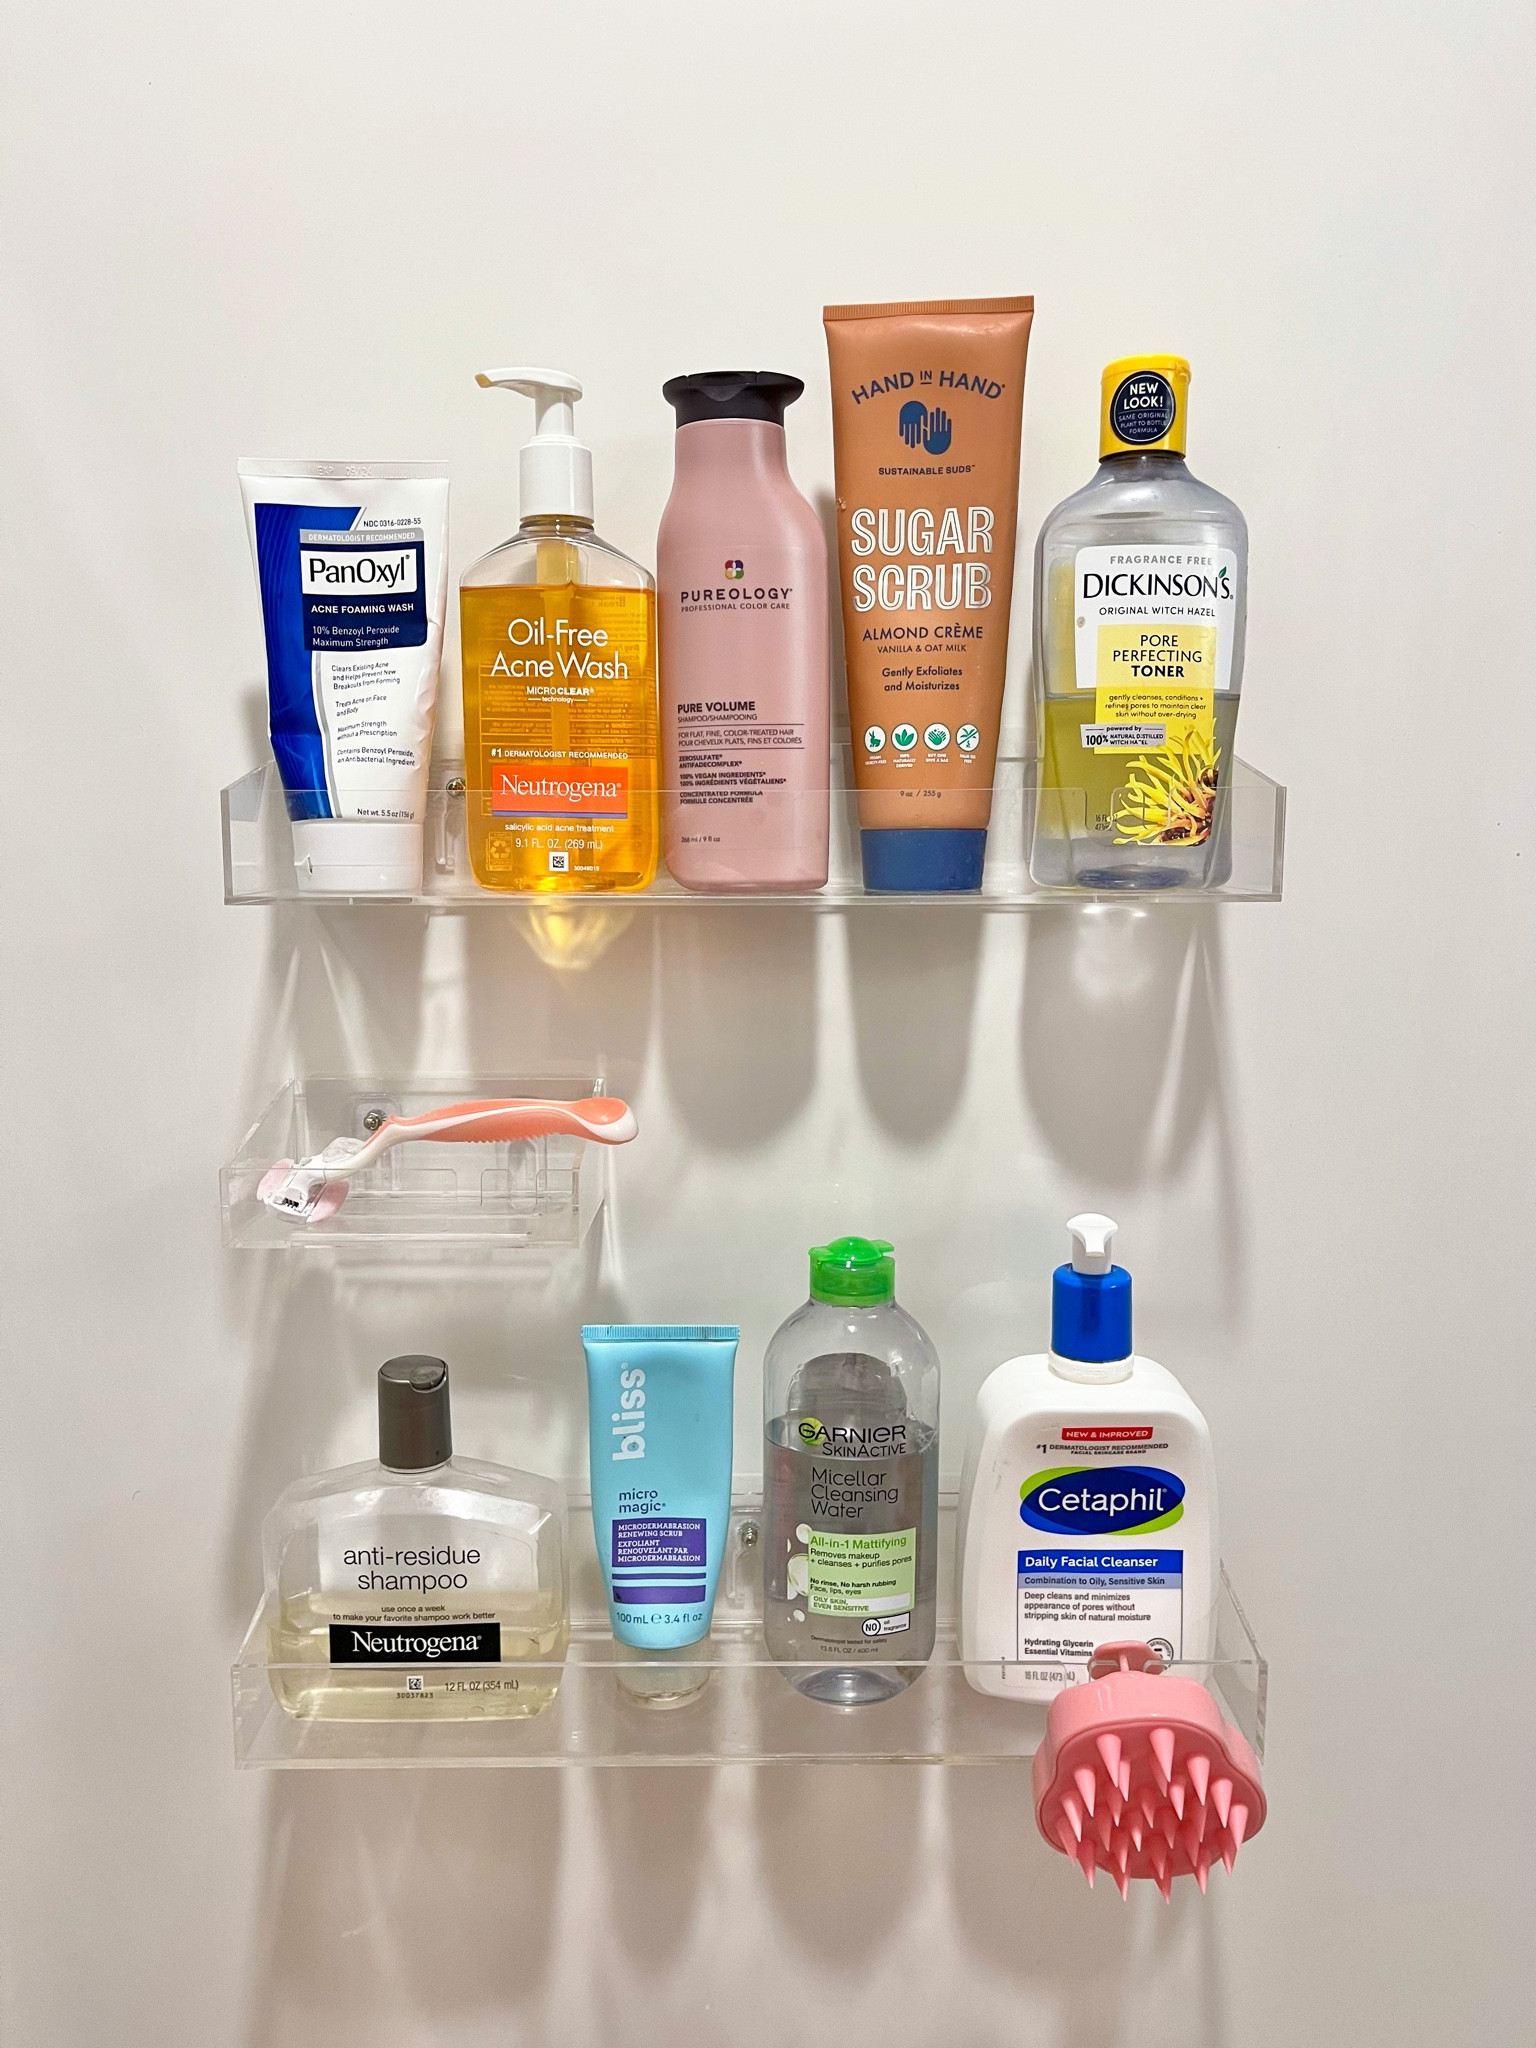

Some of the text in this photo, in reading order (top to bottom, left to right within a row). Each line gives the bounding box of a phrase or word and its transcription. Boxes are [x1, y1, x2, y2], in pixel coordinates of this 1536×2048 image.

[852, 371, 1002, 405] HAND IN HAND
[1130, 382, 1159, 395] NEW
[1124, 396, 1163, 410] LOOK!
[878, 465, 971, 475] SUSTAINABLE SUDS
[380, 518, 421, 527] 0316-0228-55
[366, 532, 415, 541] RECOMMENDED
[851, 506, 994, 556] SUGAR
[1110, 555, 1213, 566] FRAGRANCE FREE
[309, 555, 405, 588] PanOxyl
[853, 563, 992, 612] SCRUB
[1083, 573, 1230, 600] DICKINSON'S
[681, 588, 789, 603] PUREOLOGY
[311, 603, 414, 614] ACNE FOAMING WASH
[681, 603, 737, 612] PROFESSIONAL
[1099, 606, 1215, 617] ORIGINAL WITCH HAZEL
[313, 625, 400, 636] 10% Benzoyl Peroxide
[508, 617, 608, 647] Oil-Free
[862, 623, 983, 641] ALMOND CRÈME
[313, 637, 388, 647] Maximum Strength
[1140, 634, 1179, 647] PORE
[877, 645, 912, 653] VANILLA
[946, 644, 967, 652] MILK
[1113, 650, 1202, 663] PERFECTING
[490, 651, 628, 679] Acne Wash
[882, 666, 963, 678] Gently Exfoliates
[1131, 665, 1184, 677] TONER
[527, 686, 590, 696] MICROCLEAR
[884, 681, 960, 691] and Moisturizes
[1108, 694, 1131, 702] gently
[678, 702, 755, 713] PURE VOLUME
[678, 714, 757, 723] SHAMPOO/SHAMPOOING
[1158, 711, 1196, 719] over-drying
[1106, 725, 1133, 733] powered
[491, 749, 502, 758] #1
[569, 751, 628, 759] RECOMMENDED
[501, 774, 617, 802] Neutrogena
[505, 823, 534, 832] salicylic
[536, 823, 553, 831] acid
[516, 838, 603, 850] 9.1 FL. OZ. (269 mL)
[611, 1369, 646, 1461] bliss
[798, 1423, 906, 1443] GARNIER
[1099, 1430, 1148, 1438] IMPROVED
[1036, 1444, 1047, 1454] #1
[812, 1467, 886, 1486] Micellar
[619, 1488, 658, 1500] micro
[811, 1484, 898, 1503] Cleansing
[619, 1500, 661, 1514] magic
[1038, 1488, 1164, 1517] Cetaphil
[811, 1500, 864, 1518] Water
[618, 1530, 658, 1538] RENEWING
[810, 1536, 907, 1550] All-in-1 Mattifying
[343, 1545, 481, 1566] anti-residue
[810, 1548, 847, 1559] Removes
[1025, 1556, 1158, 1569] Daily Facial Cleanser
[358, 1571, 468, 1594] shampoo
[1024, 1577, 1077, 1585] Combination
[1089, 1577, 1107, 1587] Oily,
[1109, 1577, 1145, 1585] Sensitive
[1147, 1577, 1165, 1585] Skin
[1024, 1592, 1131, 1601] Deep cleans and minimizes
[1024, 1603, 1135, 1612] appearance of pores without
[384, 1614, 412, 1622] favorite
[414, 1614, 450, 1622] shampoo
[1024, 1612, 1059, 1621] stripping
[1079, 1613, 1087, 1621] of
[865, 1623, 877, 1631] NO
[351, 1631, 479, 1658] Neutrogena
[1024, 1638, 1094, 1648] Hydrating Glycerin
[1024, 1648, 1058, 1656] Essential
[445, 1680, 518, 1692] 12 FL OZ (354 mL)
